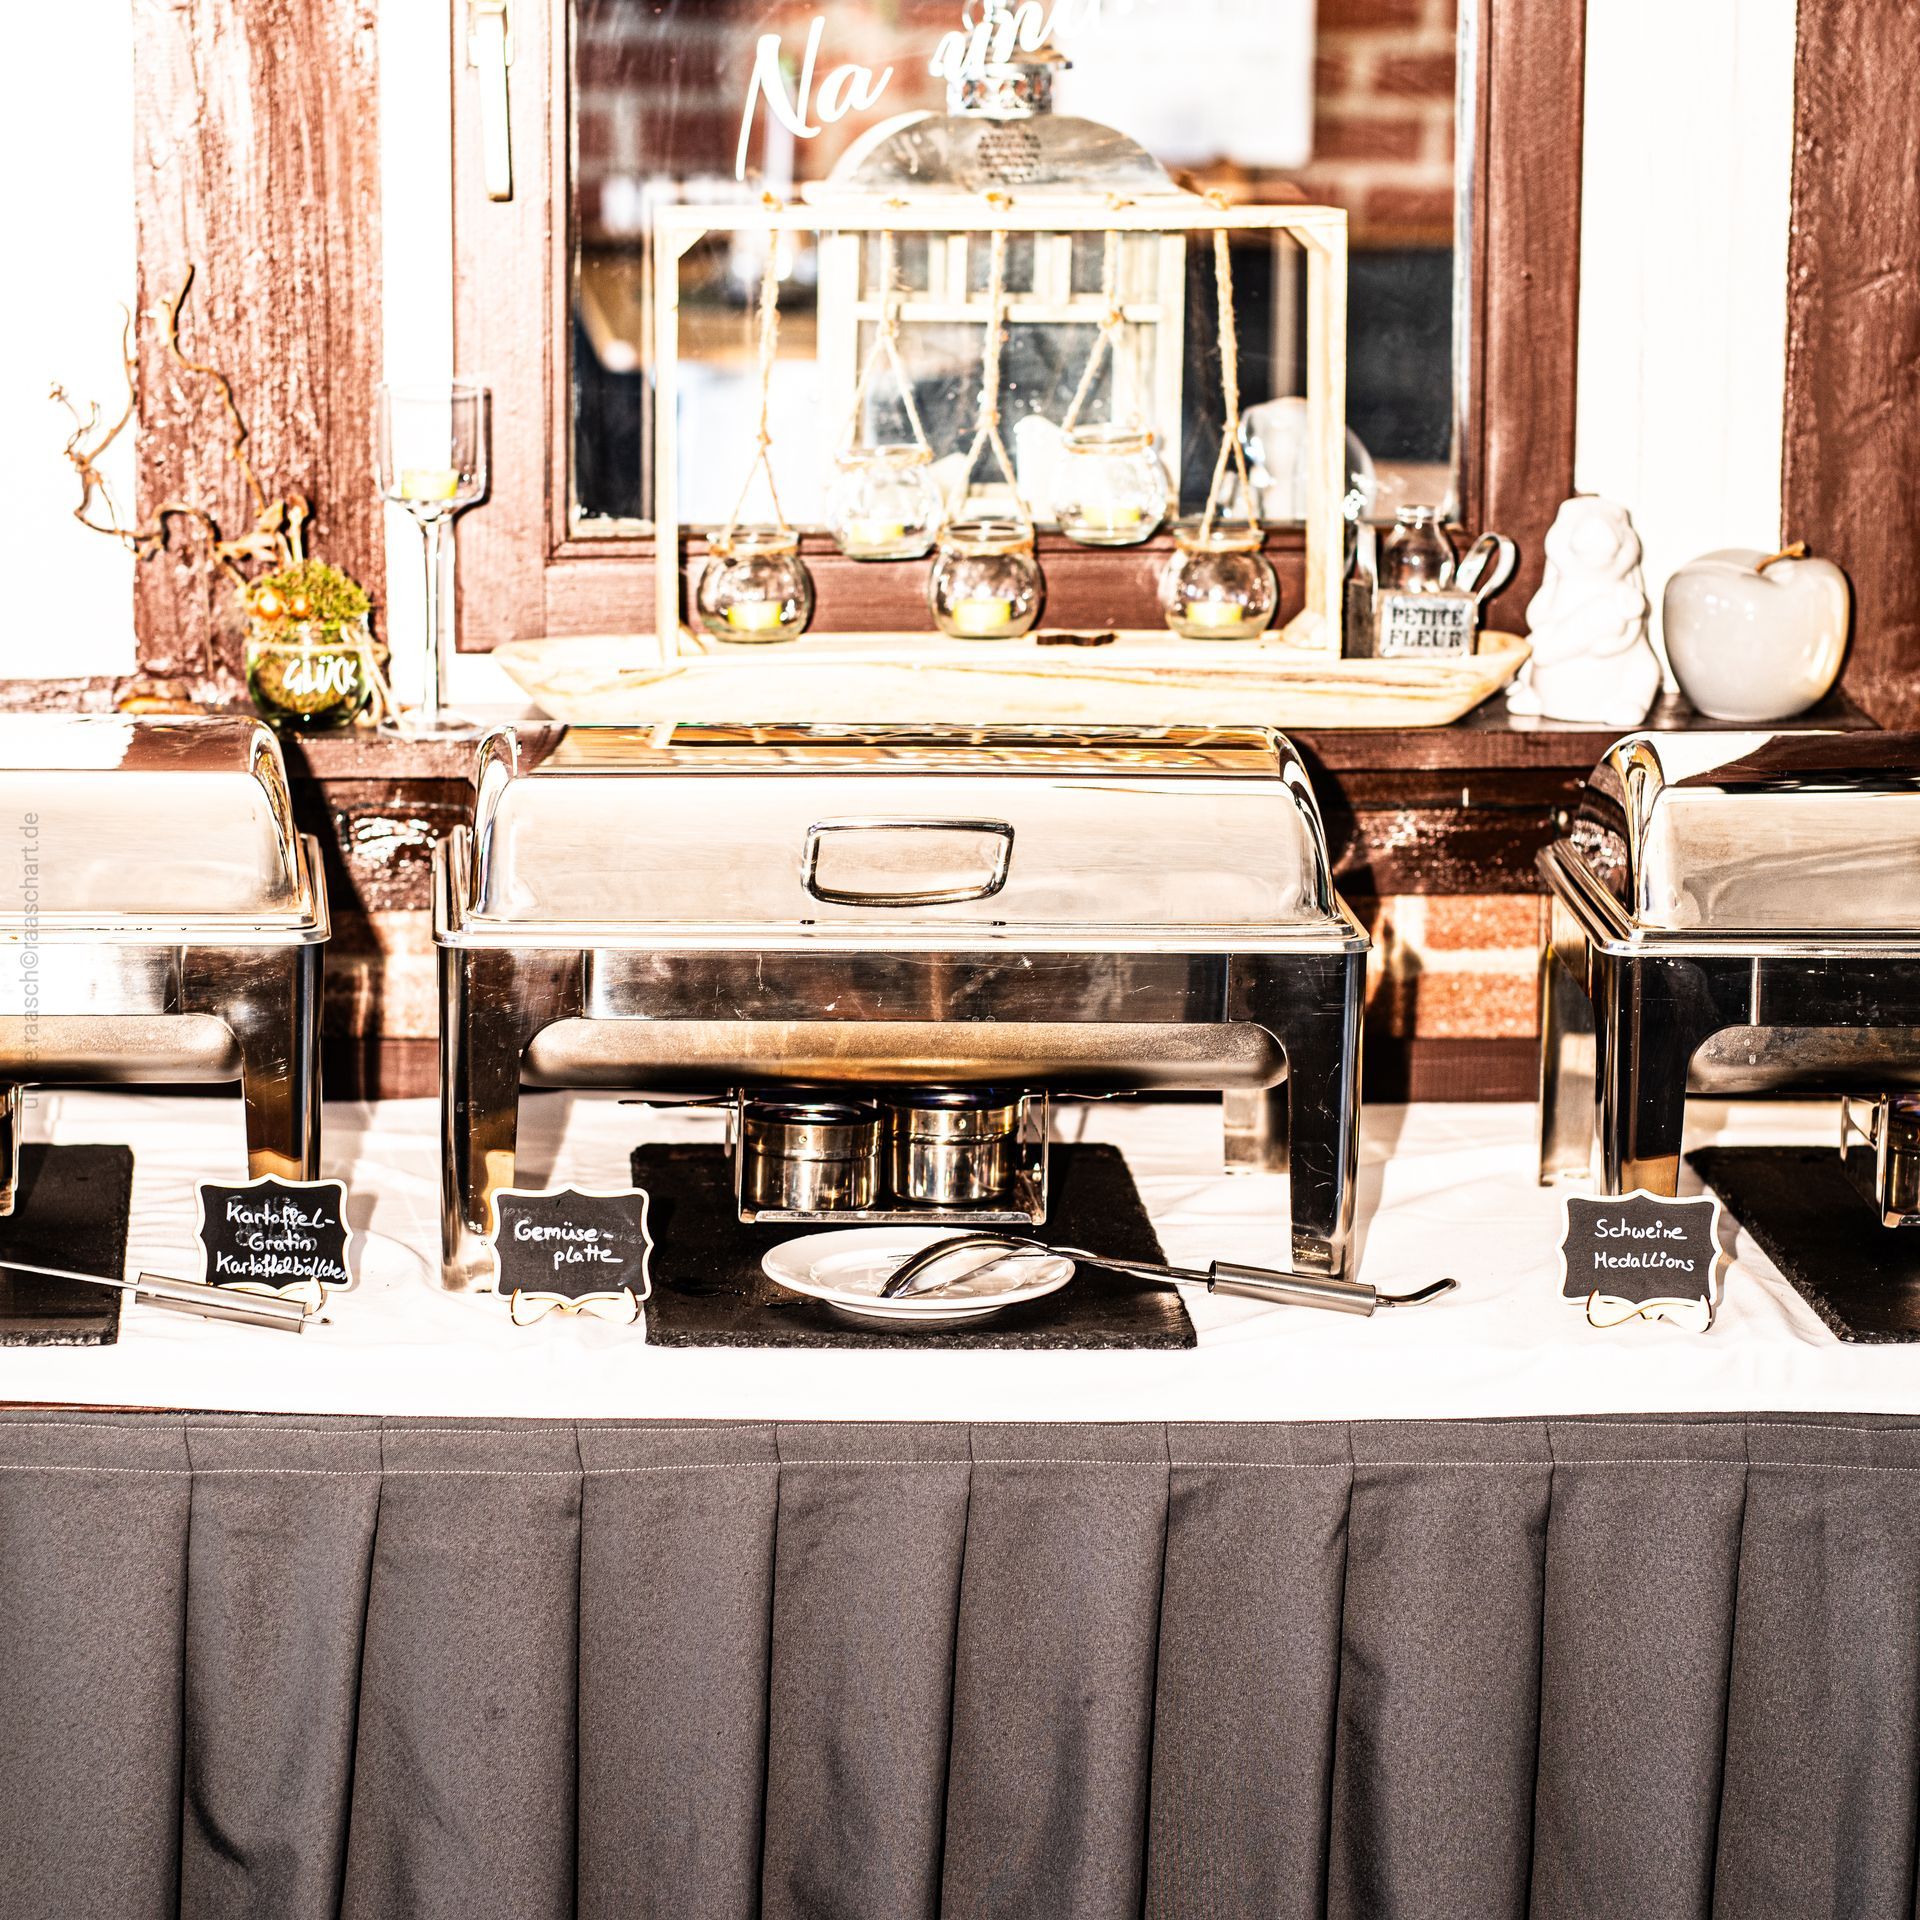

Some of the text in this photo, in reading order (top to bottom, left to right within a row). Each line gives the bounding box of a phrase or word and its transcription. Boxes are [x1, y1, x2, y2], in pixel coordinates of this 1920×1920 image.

[735, 15, 893, 181] Na
[1391, 606, 1463, 627] PETITE
[1389, 628, 1462, 649] FLEUR
[226, 1201, 336, 1231] Kartoffel-
[249, 1229, 313, 1252] Gratin
[514, 1220, 614, 1243] Gemüse-
[1594, 1217, 1688, 1241] Schweine
[553, 1243, 624, 1271] platte
[1594, 1250, 1695, 1272] Medallions
